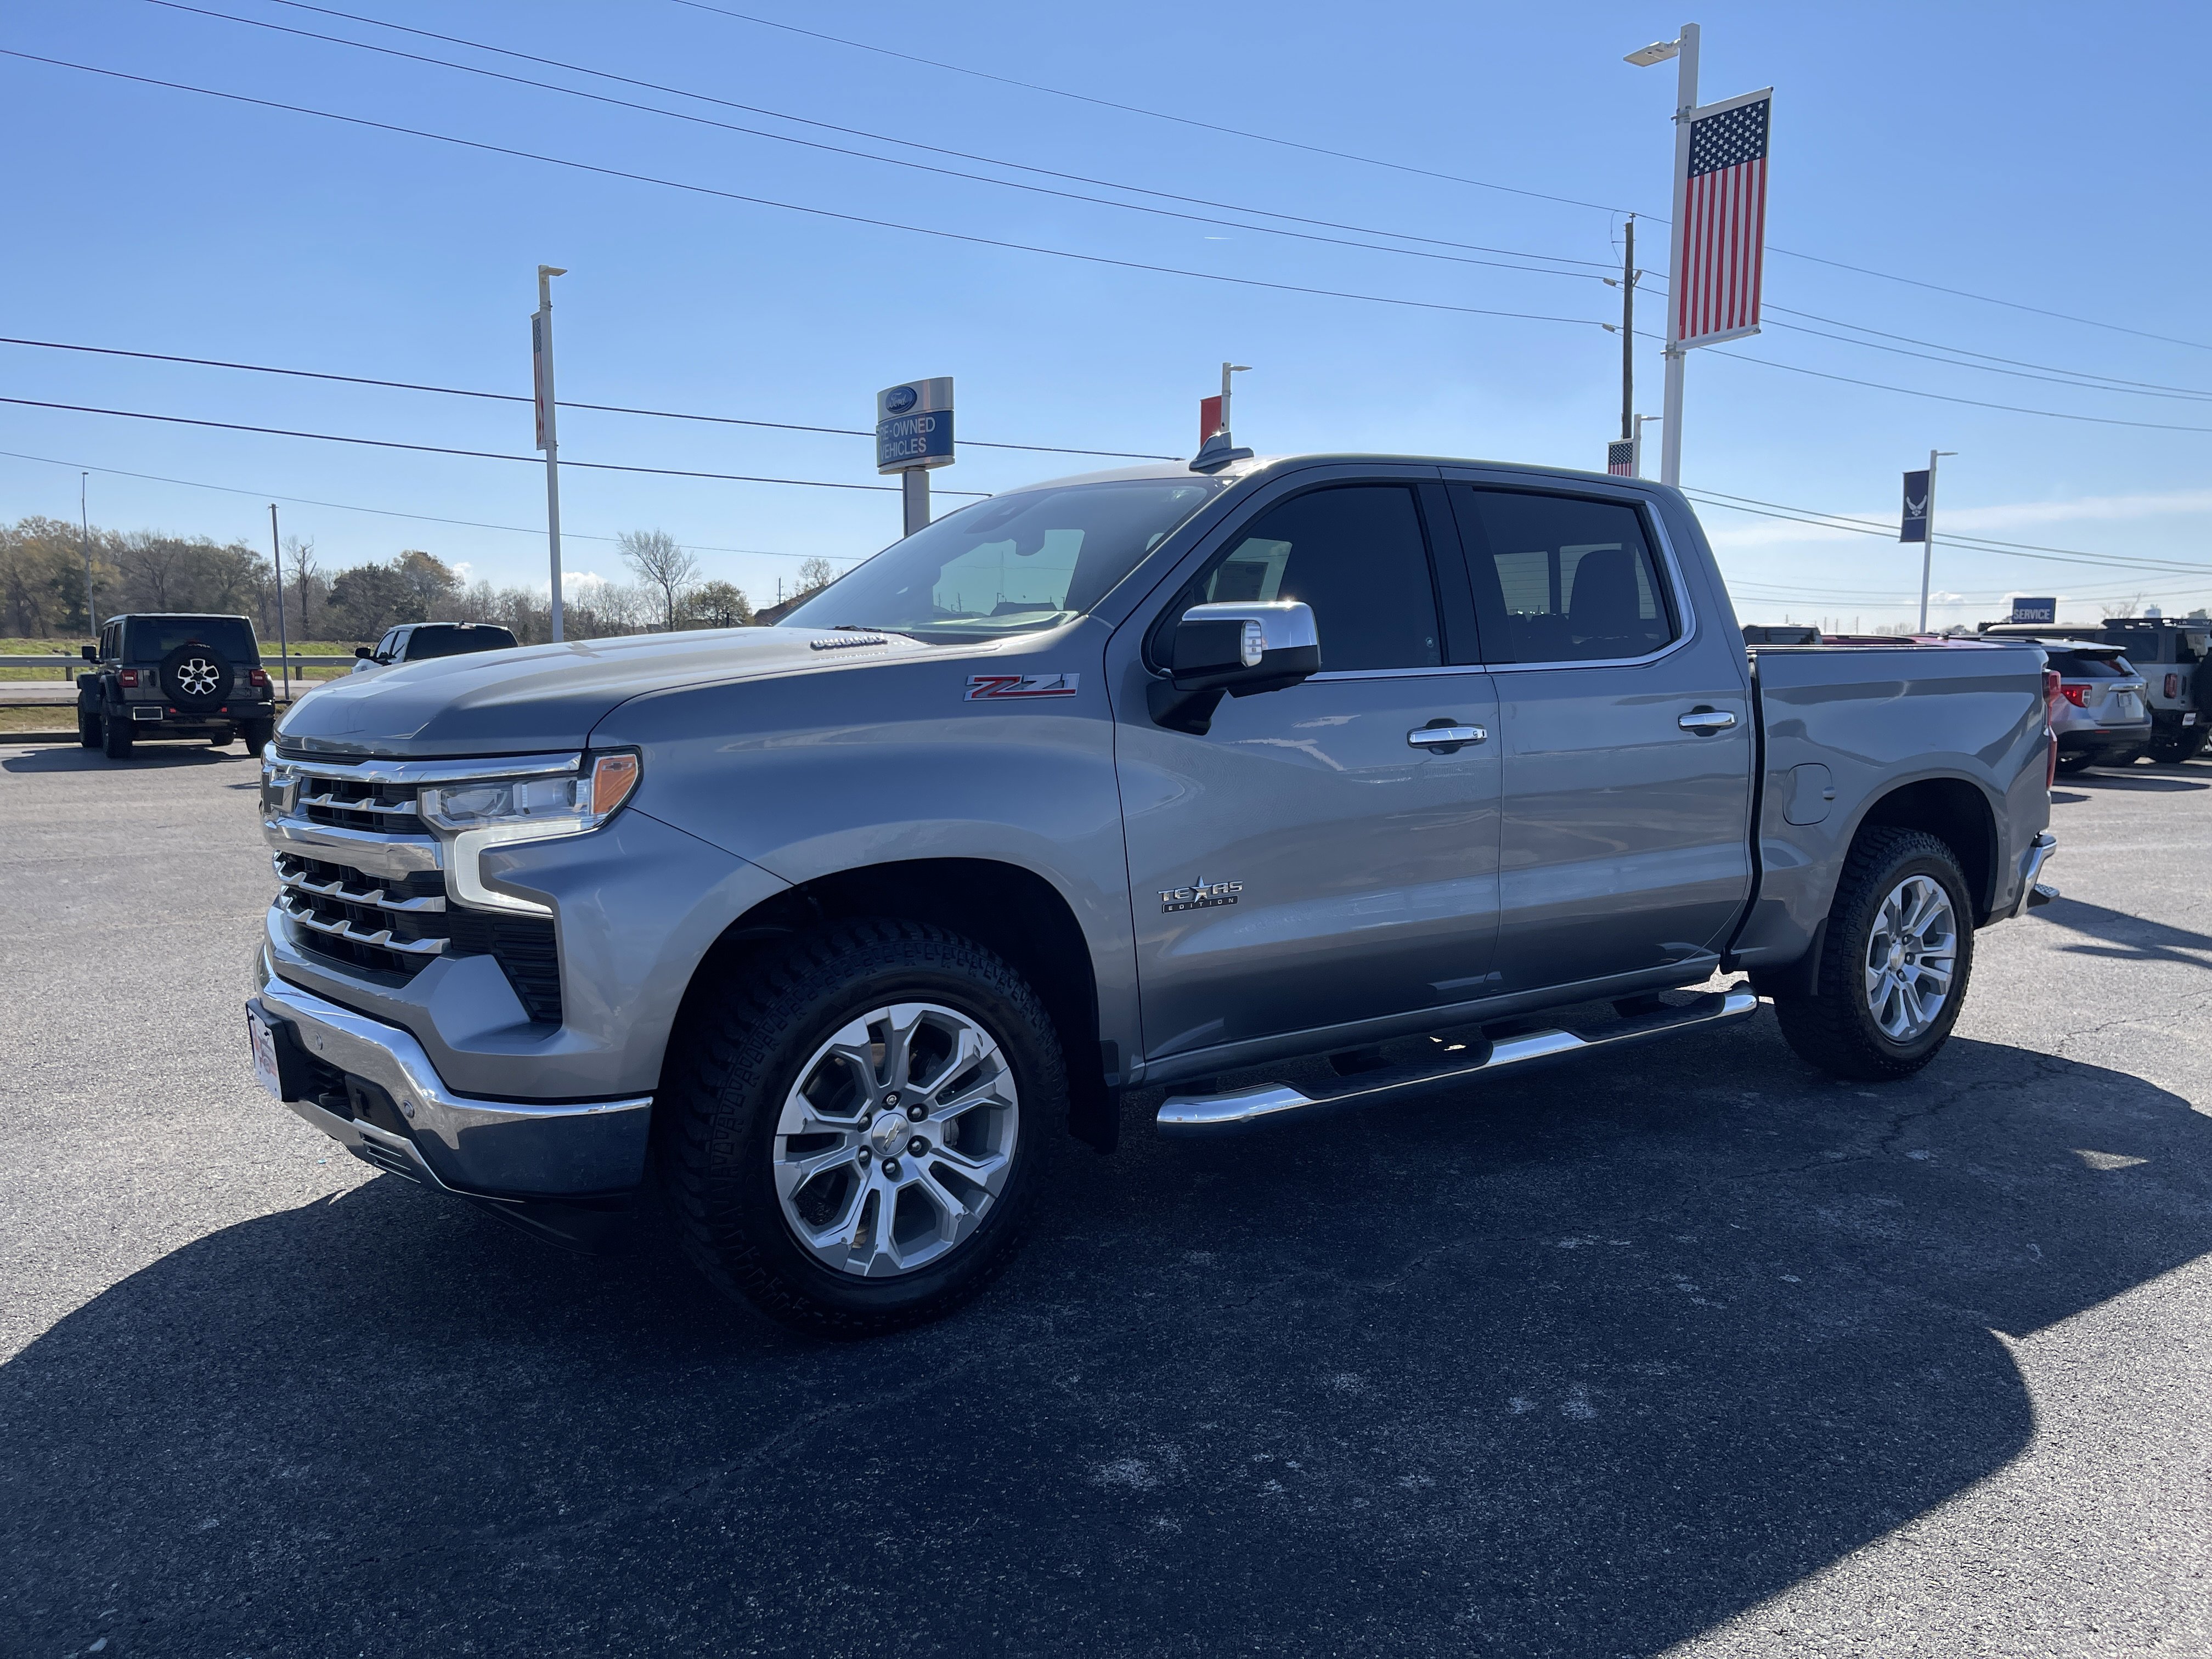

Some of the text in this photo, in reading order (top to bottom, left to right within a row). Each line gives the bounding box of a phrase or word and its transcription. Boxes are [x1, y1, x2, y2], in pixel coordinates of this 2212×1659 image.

[889, 392, 907, 408] Ford
[880, 437, 927, 460] VEHICLES
[2013, 608, 2050, 620] SERVICE
[963, 673, 1080, 702] Z71
[1168, 898, 1234, 911] EDITION
